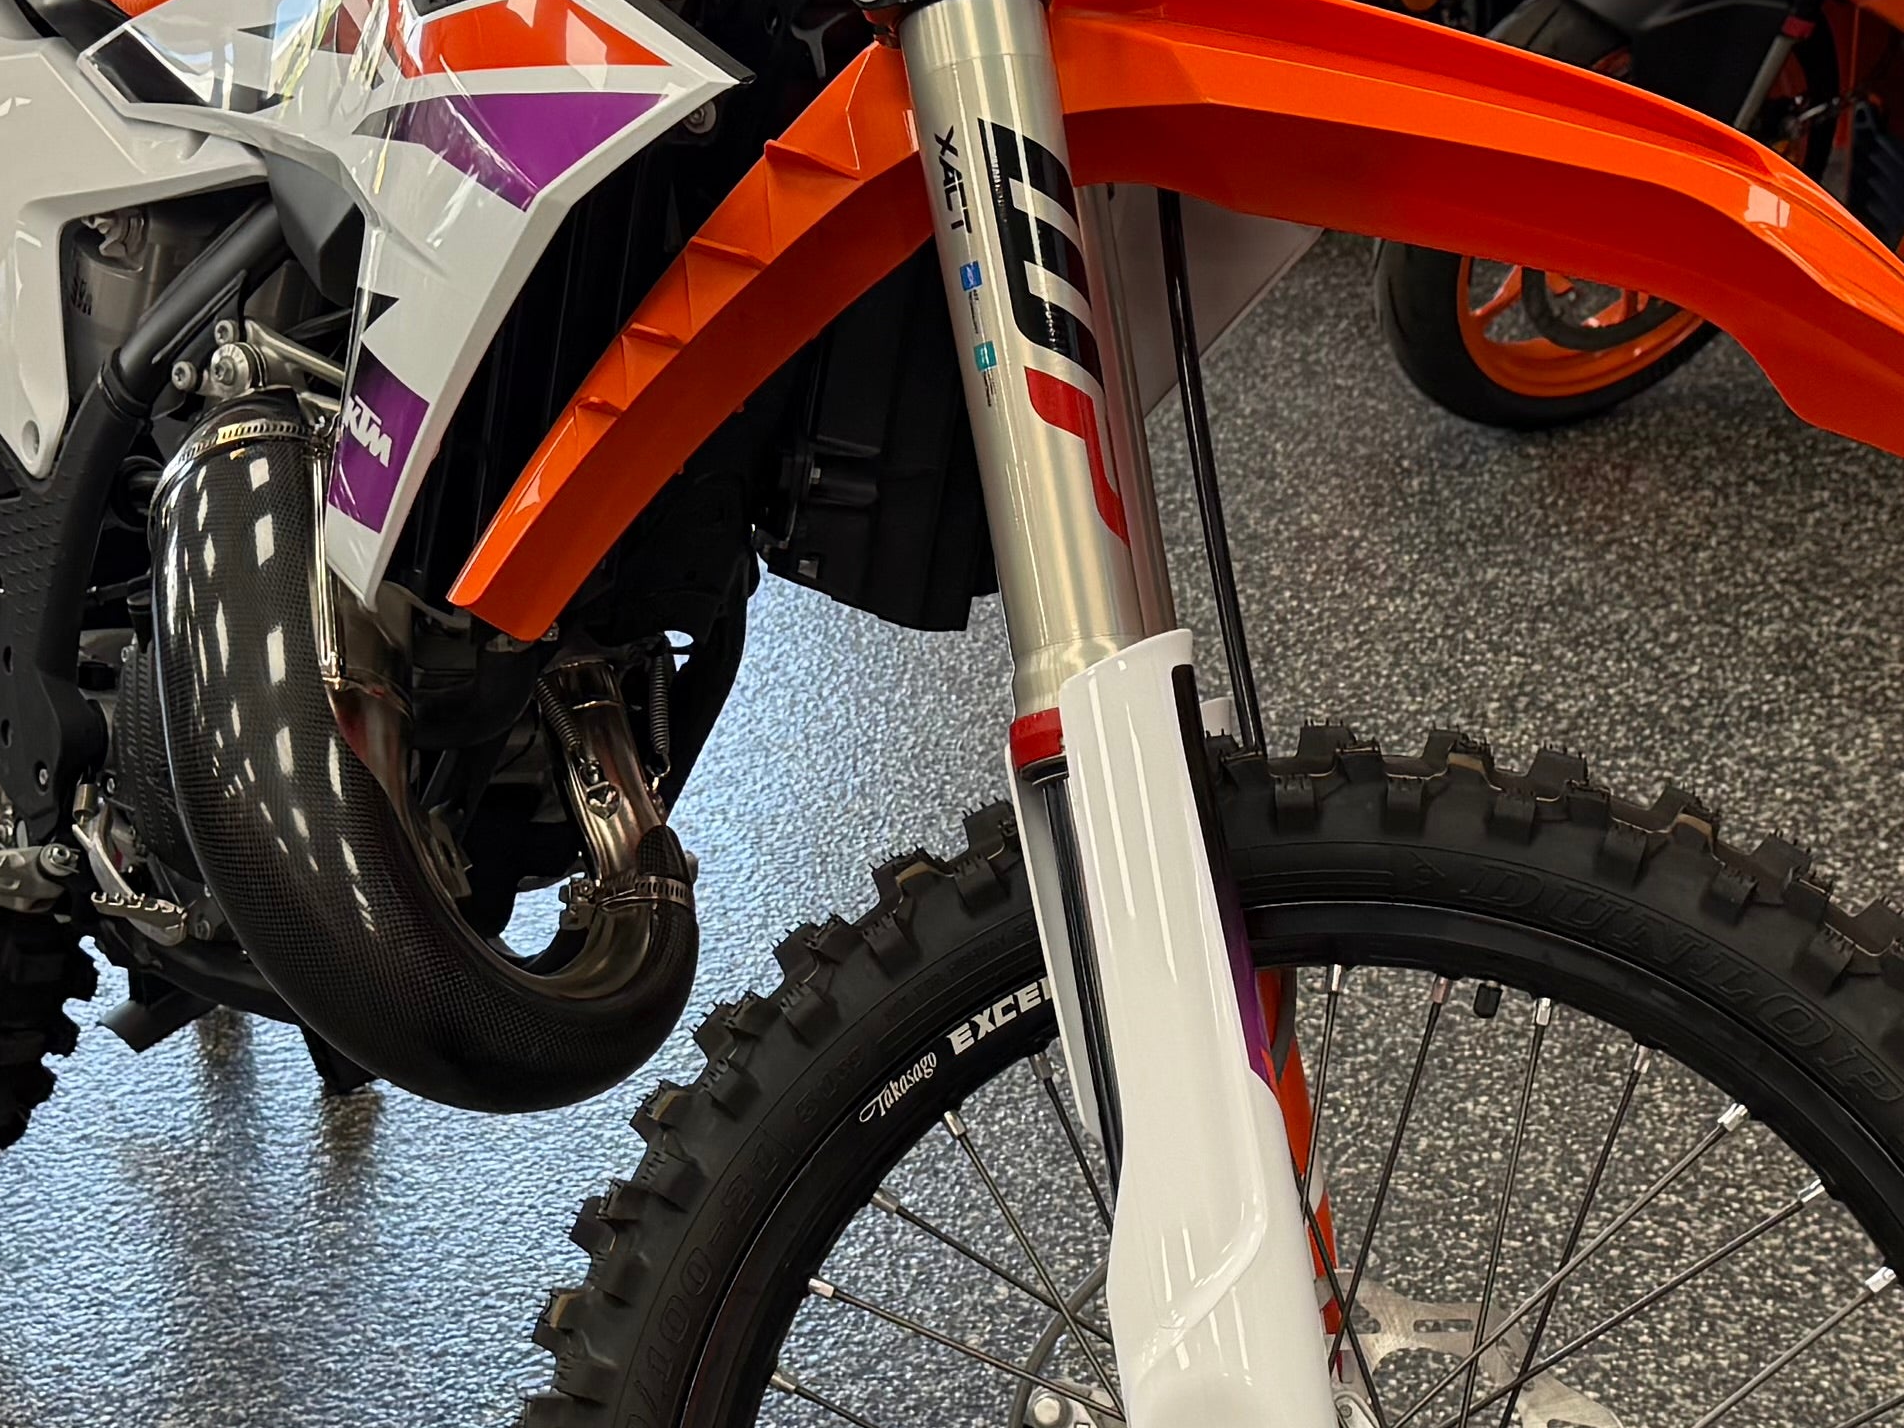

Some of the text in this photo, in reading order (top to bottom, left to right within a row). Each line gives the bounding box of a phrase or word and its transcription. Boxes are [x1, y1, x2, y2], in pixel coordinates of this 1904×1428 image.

[934, 125, 973, 234] XACT
[342, 394, 393, 468] KTM
[857, 1051, 938, 1125] Takasago
